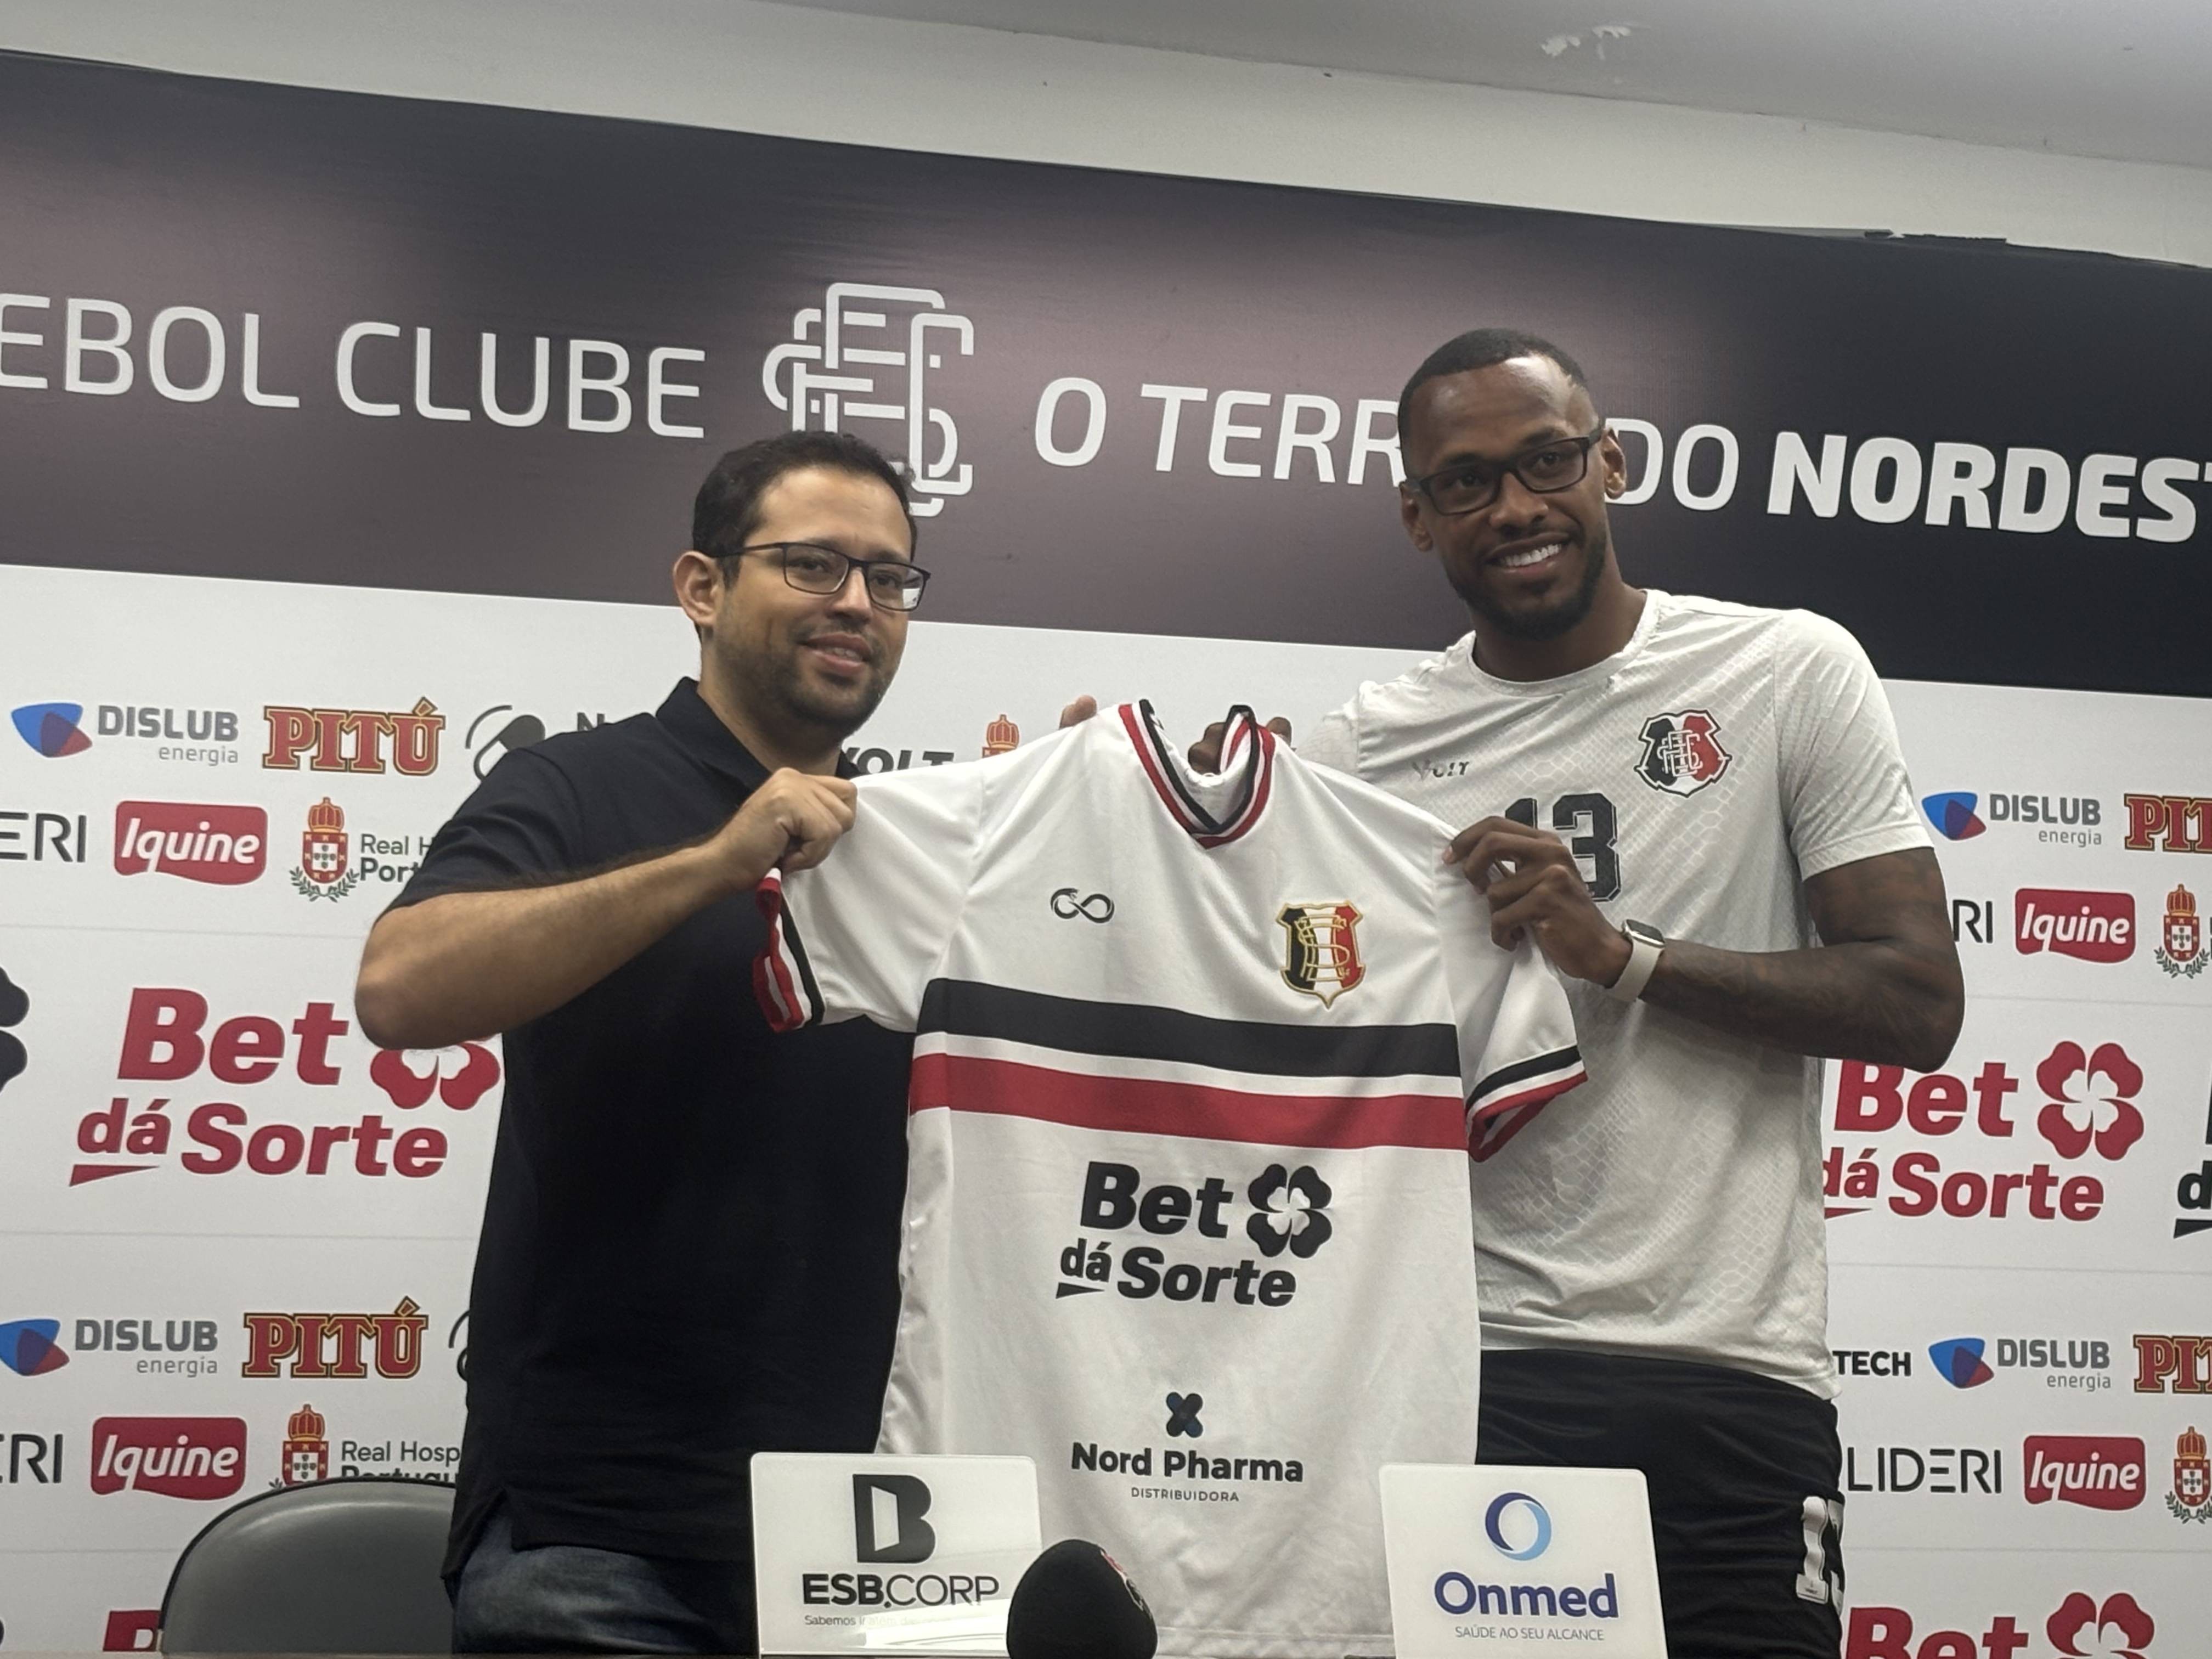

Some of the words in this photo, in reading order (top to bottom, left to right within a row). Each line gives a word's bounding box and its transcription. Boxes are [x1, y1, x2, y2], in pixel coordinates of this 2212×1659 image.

[0, 294, 300, 409] EBOL
[336, 321, 706, 438] CLUBE
[1035, 377, 1107, 467] O
[1603, 417, 1739, 511] DO
[1767, 431, 2212, 543] NORDES
[98, 705, 239, 741] DISLUB
[262, 696, 446, 777] PITÚ
[159, 744, 239, 766] energia
[1989, 794, 2101, 825] DISLUB
[0, 811, 87, 862] ERI
[121, 817, 260, 872] Iquine
[361, 833, 409, 855] Real
[2039, 828, 2102, 847] energia
[2021, 903, 2130, 951] Iquine
[117, 988, 349, 1086] Bet
[1834, 1059, 2018, 1137] Bet
[77, 1098, 171, 1155] dá
[181, 1102, 448, 1178] Sorte
[1080, 1161, 1233, 1238] Bet
[1822, 1147, 1879, 1199] dá
[1888, 1152, 2104, 1221] Sorte
[1060, 1238, 1111, 1282] dá
[1118, 1246, 1296, 1307] Sorte
[75, 1319, 218, 1351] DISLUB
[242, 1296, 429, 1379] PITÚ
[1997, 1339, 2110, 1368] DISLUB
[137, 1357, 218, 1378] energia
[1832, 1351, 1911, 1376] TECH
[2047, 1374, 2111, 1392] energia
[0, 1434, 63, 1483] RI
[98, 1435, 239, 1491] Iquine
[342, 1441, 390, 1462] Real
[400, 1441, 460, 1467] Hosp
[1071, 1442, 1152, 1476] Nord
[1164, 1450, 1304, 1482] Pharma
[1847, 1447, 2001, 1494] LIDERI
[2029, 1450, 2140, 1500] Iquine
[1131, 1487, 1239, 1502] DISTRIBUIDORA
[802, 1573, 1000, 1608] ESB.CORP
[1435, 1571, 1619, 1618] Onmed
[804, 1615, 856, 1626] Sabemos
[1455, 1624, 1496, 1638] SAÚDE
[1499, 1627, 1518, 1639] AO
[1520, 1627, 1544, 1639] SEU
[1547, 1628, 1604, 1640] ALCANCE
[1846, 1607, 2028, 1659] Bet
